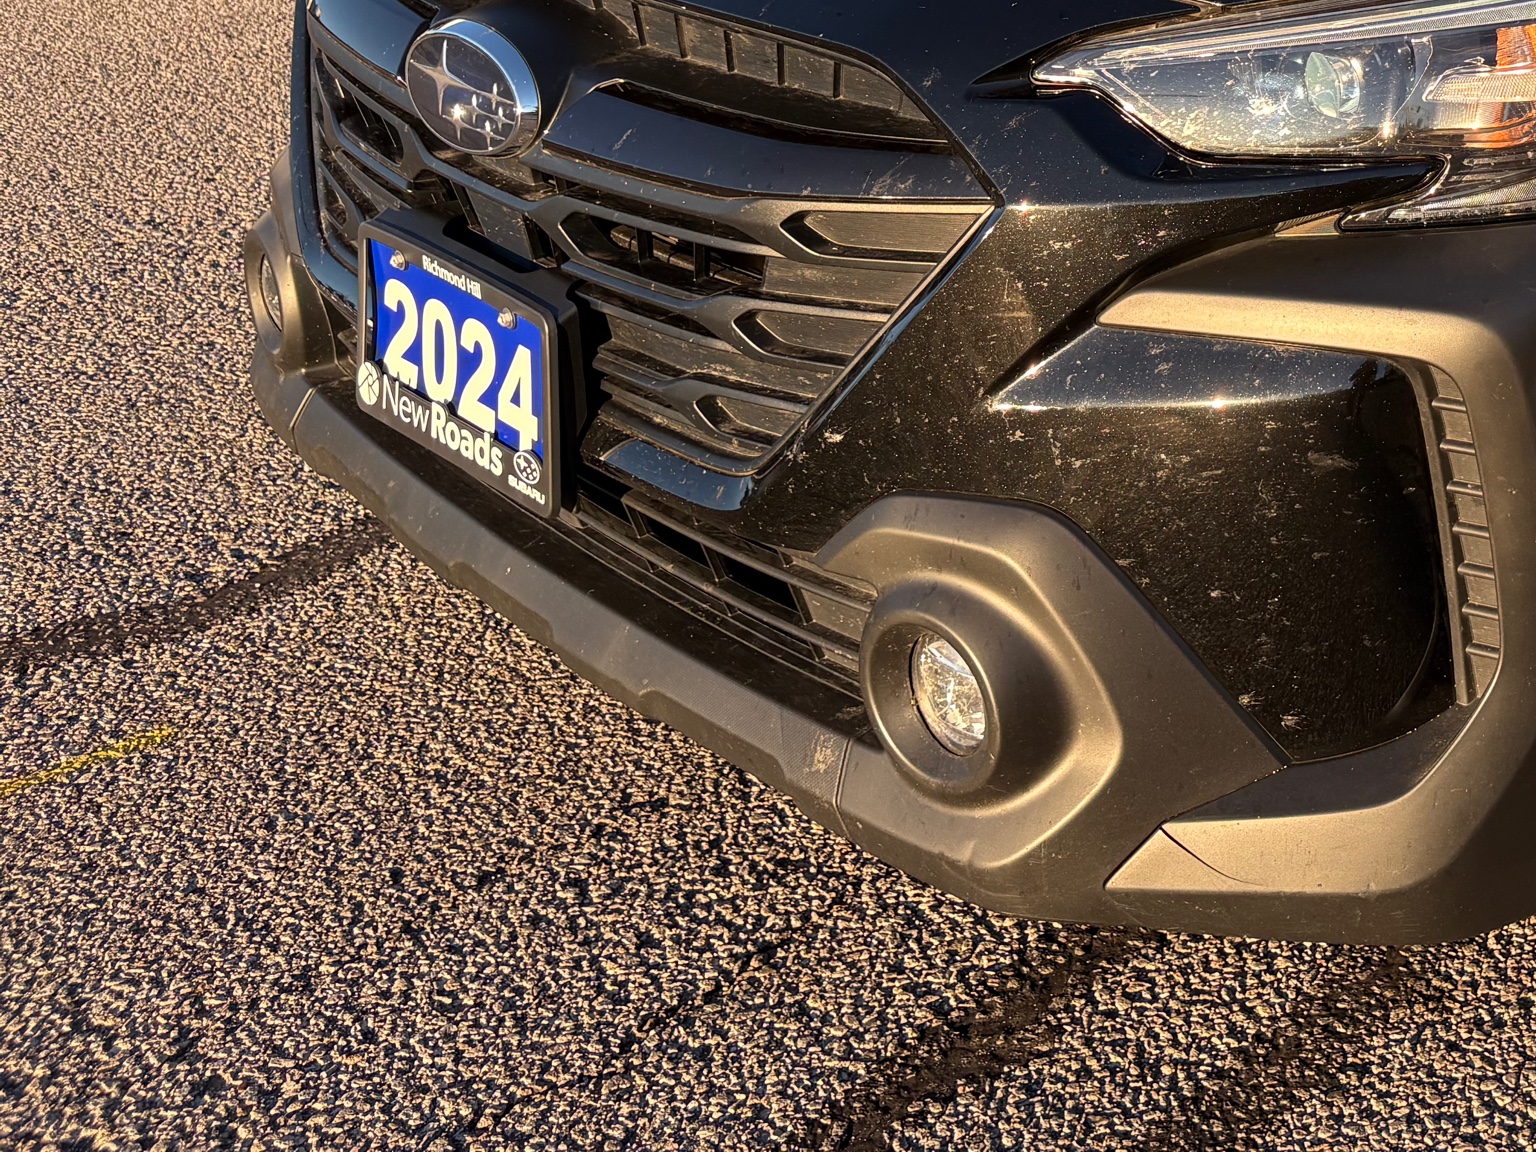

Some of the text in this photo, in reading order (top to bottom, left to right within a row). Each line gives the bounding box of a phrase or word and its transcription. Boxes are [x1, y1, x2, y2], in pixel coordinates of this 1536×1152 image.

[422, 254, 482, 300] Richmond Hill
[383, 278, 538, 451] 2024
[507, 474, 546, 505] SUBARU
